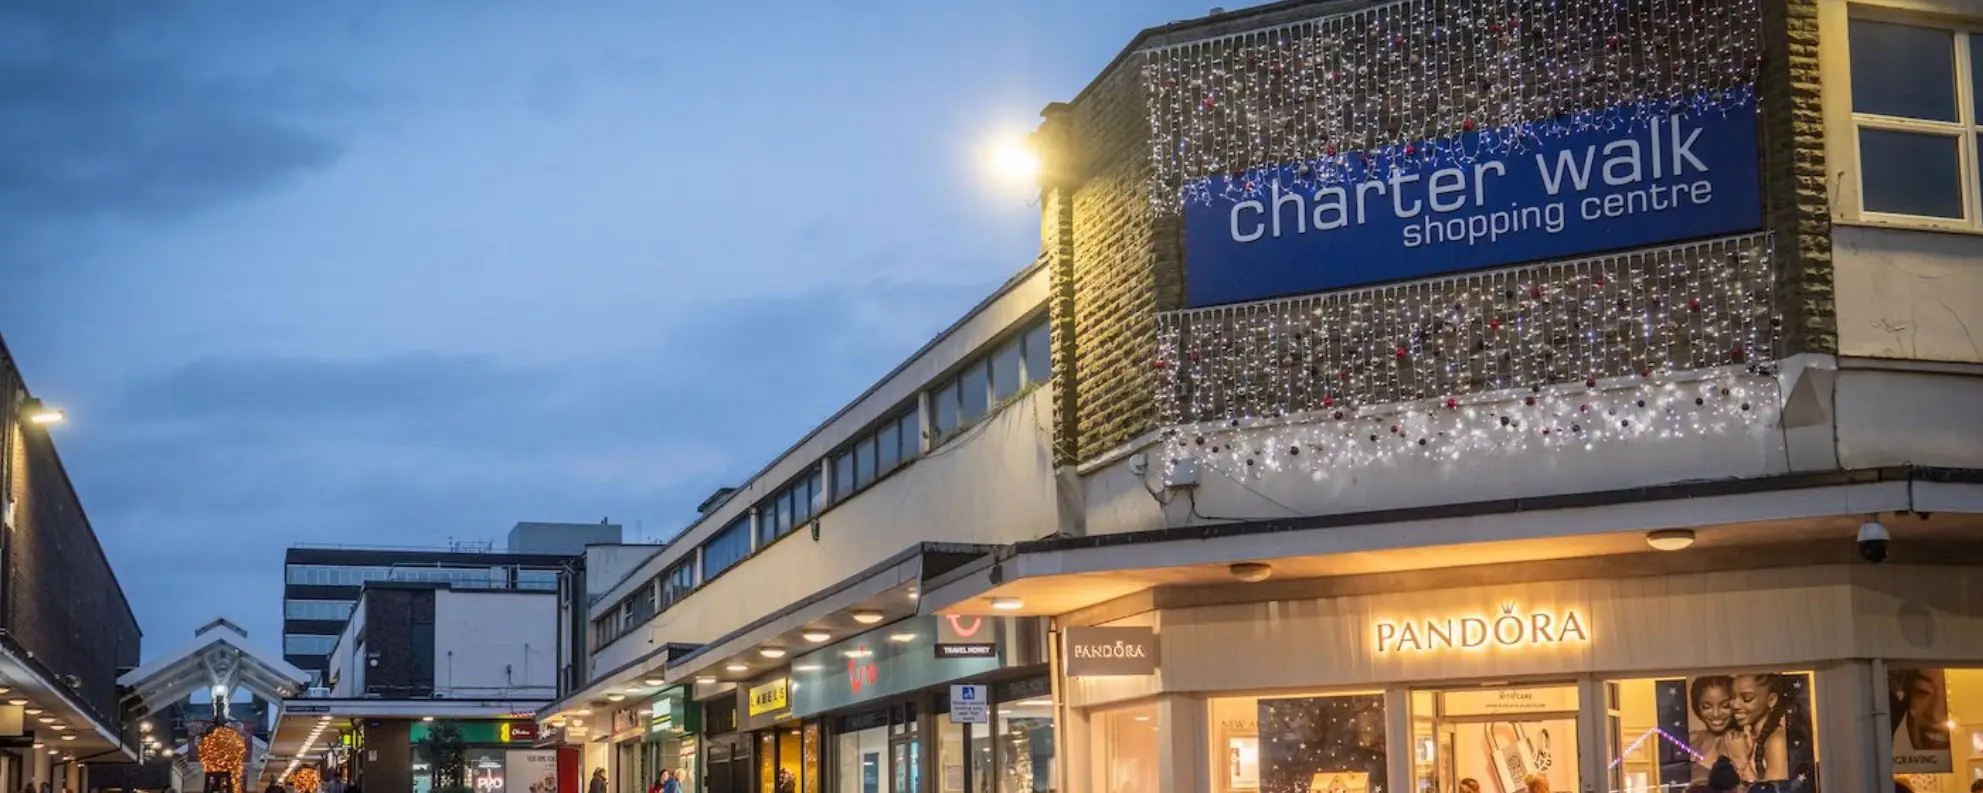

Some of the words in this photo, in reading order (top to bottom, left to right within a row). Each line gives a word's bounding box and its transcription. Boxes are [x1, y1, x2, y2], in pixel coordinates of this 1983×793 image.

[1230, 160, 1505, 244] charter
[1535, 113, 1710, 196] walk
[1402, 204, 1566, 248] shopping
[1580, 177, 1713, 222] centre
[1376, 608, 1586, 652] PANDORA
[943, 646, 967, 654] TRAVEL
[967, 646, 991, 654] MONEY
[1074, 641, 1147, 658] PANDORA
[750, 687, 785, 708] LABELS
